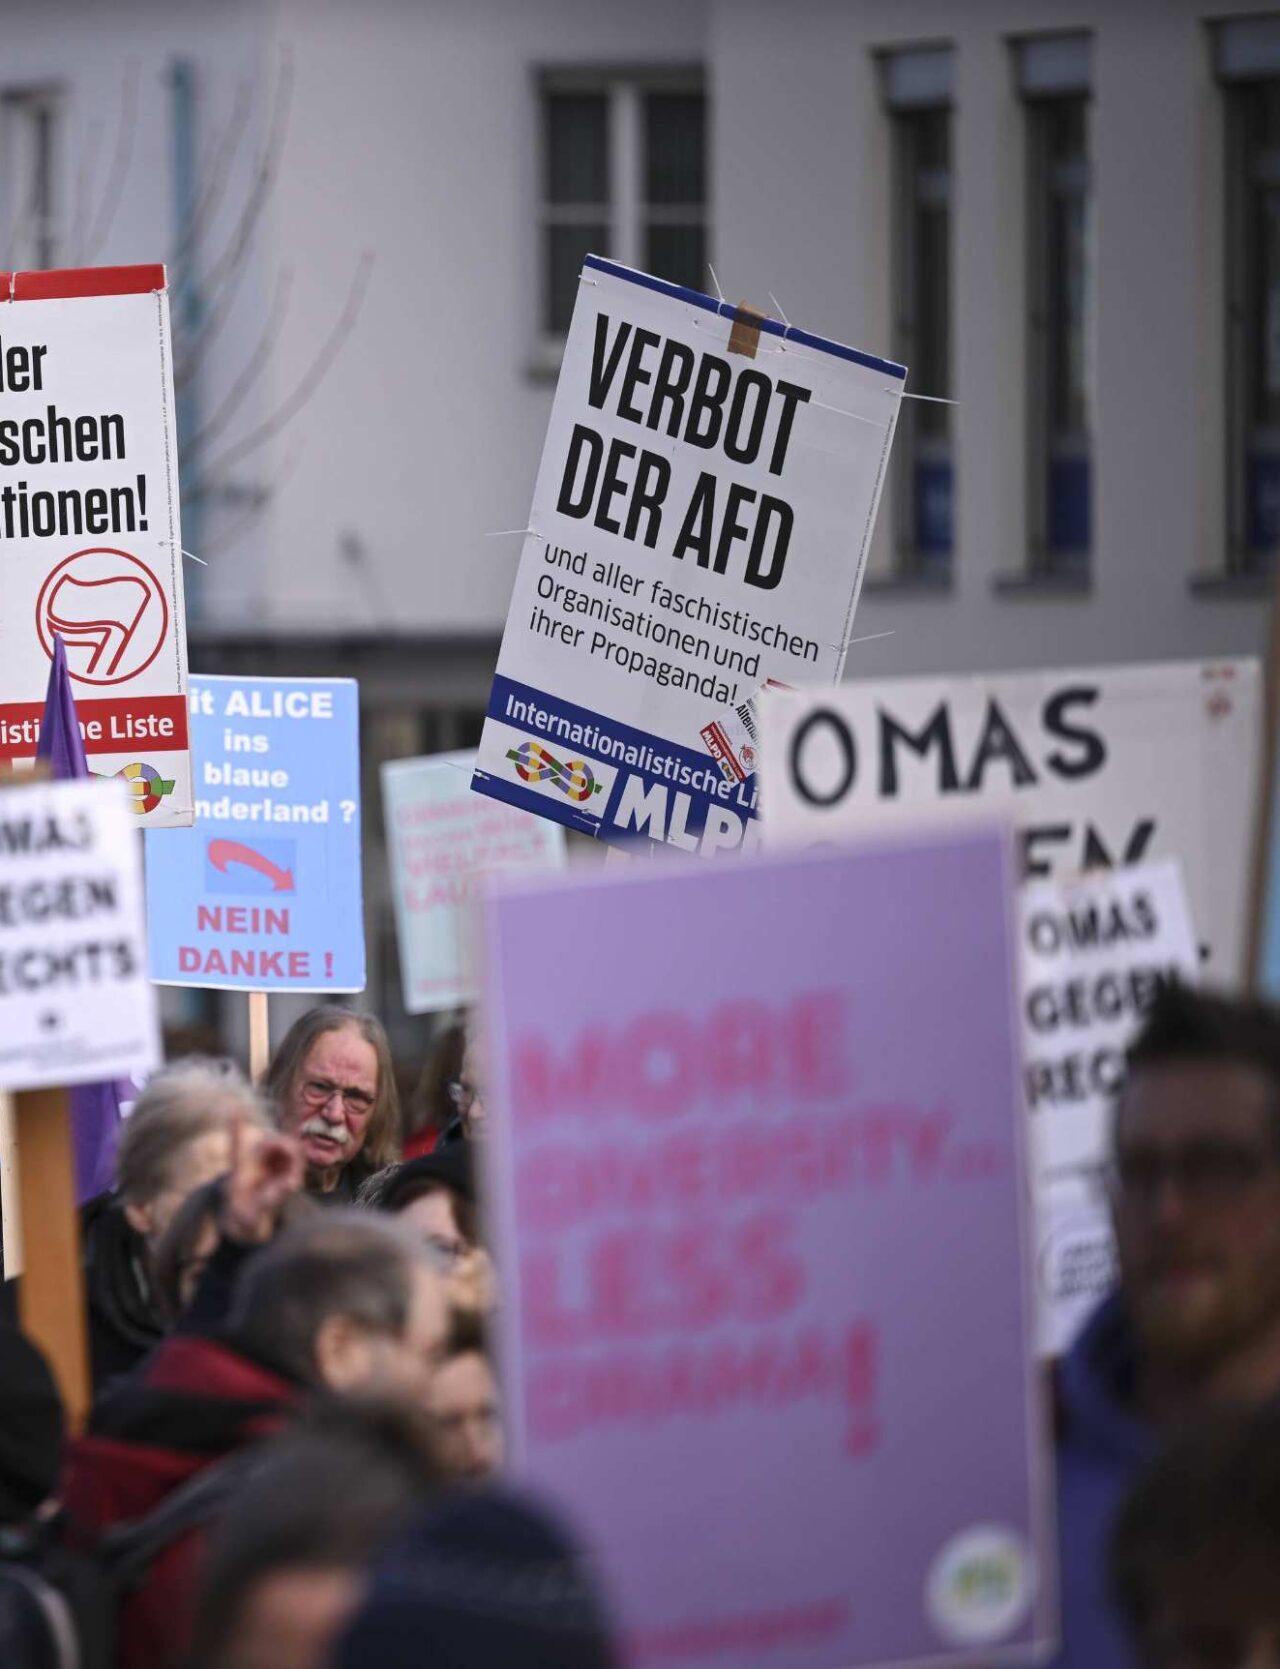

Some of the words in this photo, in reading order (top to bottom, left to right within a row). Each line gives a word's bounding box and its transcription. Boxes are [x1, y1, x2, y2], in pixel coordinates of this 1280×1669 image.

[588, 312, 812, 476] VERBOT
[556, 423, 672, 549] DER
[671, 471, 795, 590] AFD
[536, 574, 719, 660] Organisationen
[713, 643, 761, 677] und
[544, 543, 587, 576] und
[592, 561, 644, 597] aller
[650, 581, 819, 662] faschistischen
[529, 606, 585, 647] ihrer
[590, 632, 738, 708] Propaganda!
[110, 713, 174, 739] Liste
[189, 687, 214, 715] it
[224, 690, 333, 718] ALICE
[223, 728, 269, 753] ins
[505, 694, 732, 800] Internationalistische
[789, 685, 1109, 808] OMAS
[204, 761, 289, 788] blaue
[194, 796, 329, 823] nderland
[197, 904, 290, 934] NEIN
[1028, 892, 1158, 953] OMAS
[178, 946, 311, 978] DANKE
[1026, 1048, 1125, 1108] REC
